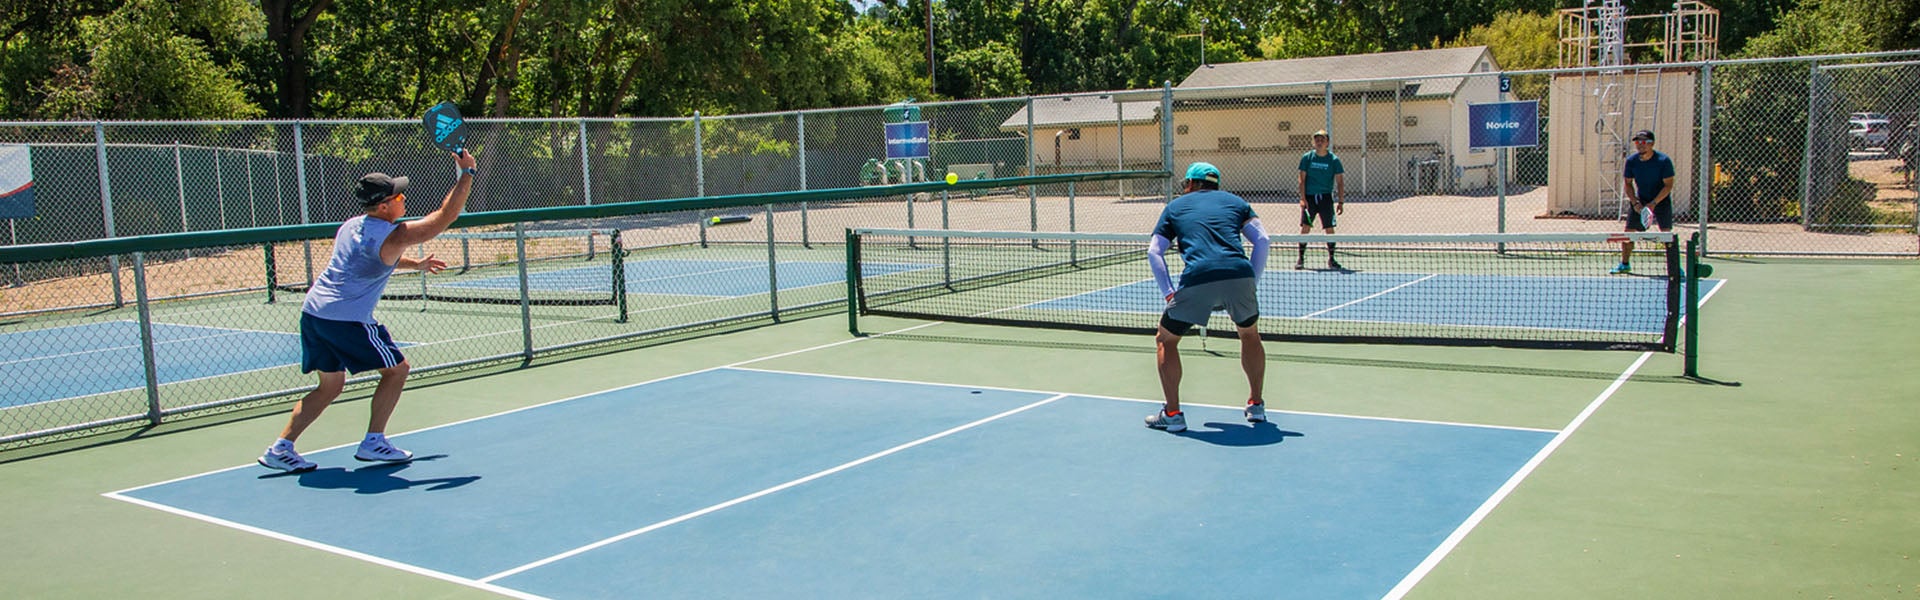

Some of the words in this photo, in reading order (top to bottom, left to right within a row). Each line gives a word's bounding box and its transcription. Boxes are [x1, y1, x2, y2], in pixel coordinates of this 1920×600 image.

[1501, 79, 1509, 91] 3
[435, 118, 463, 143] adidas
[1485, 120, 1520, 130] Novice
[888, 136, 927, 145] Intermediate
